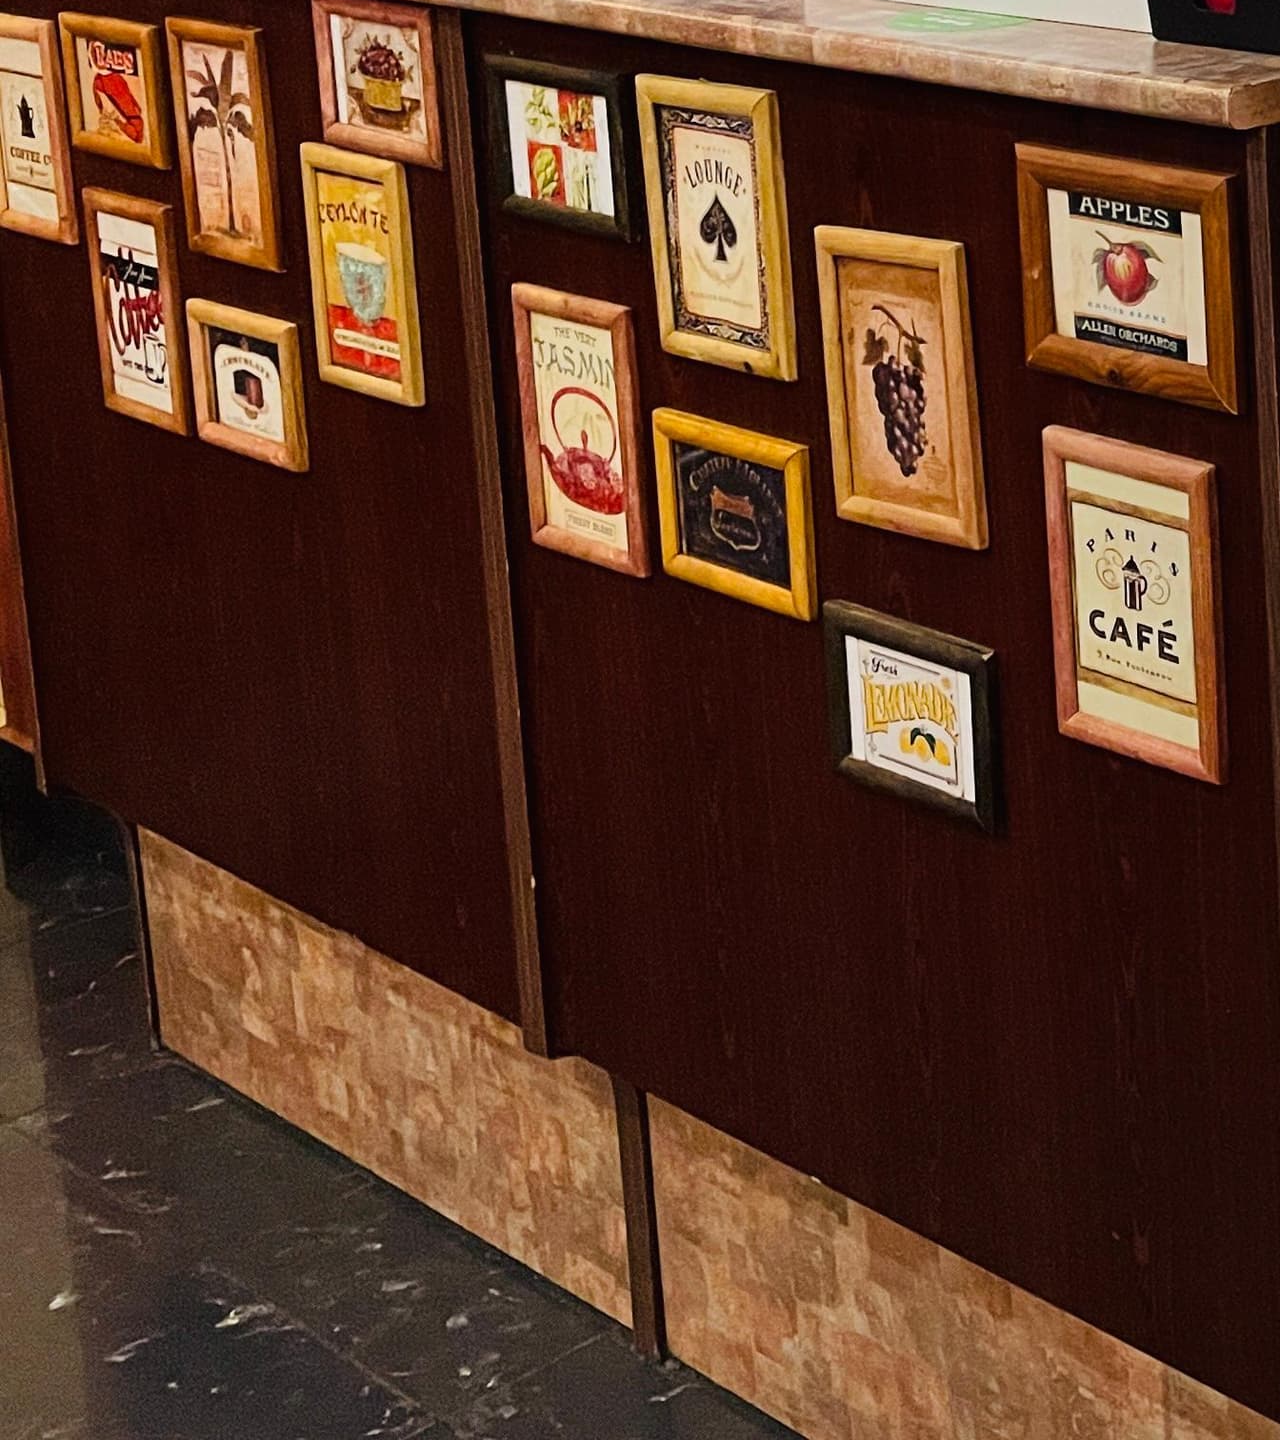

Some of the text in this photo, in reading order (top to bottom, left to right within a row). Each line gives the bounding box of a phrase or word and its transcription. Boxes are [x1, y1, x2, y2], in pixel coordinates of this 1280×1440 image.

[685, 158, 744, 198] LOUNGE
[1079, 195, 1170, 230] APPLES
[1086, 527, 1180, 577] PARIS
[1088, 608, 1181, 665] CAFÉ
[863, 678, 958, 745] LEMONADE
